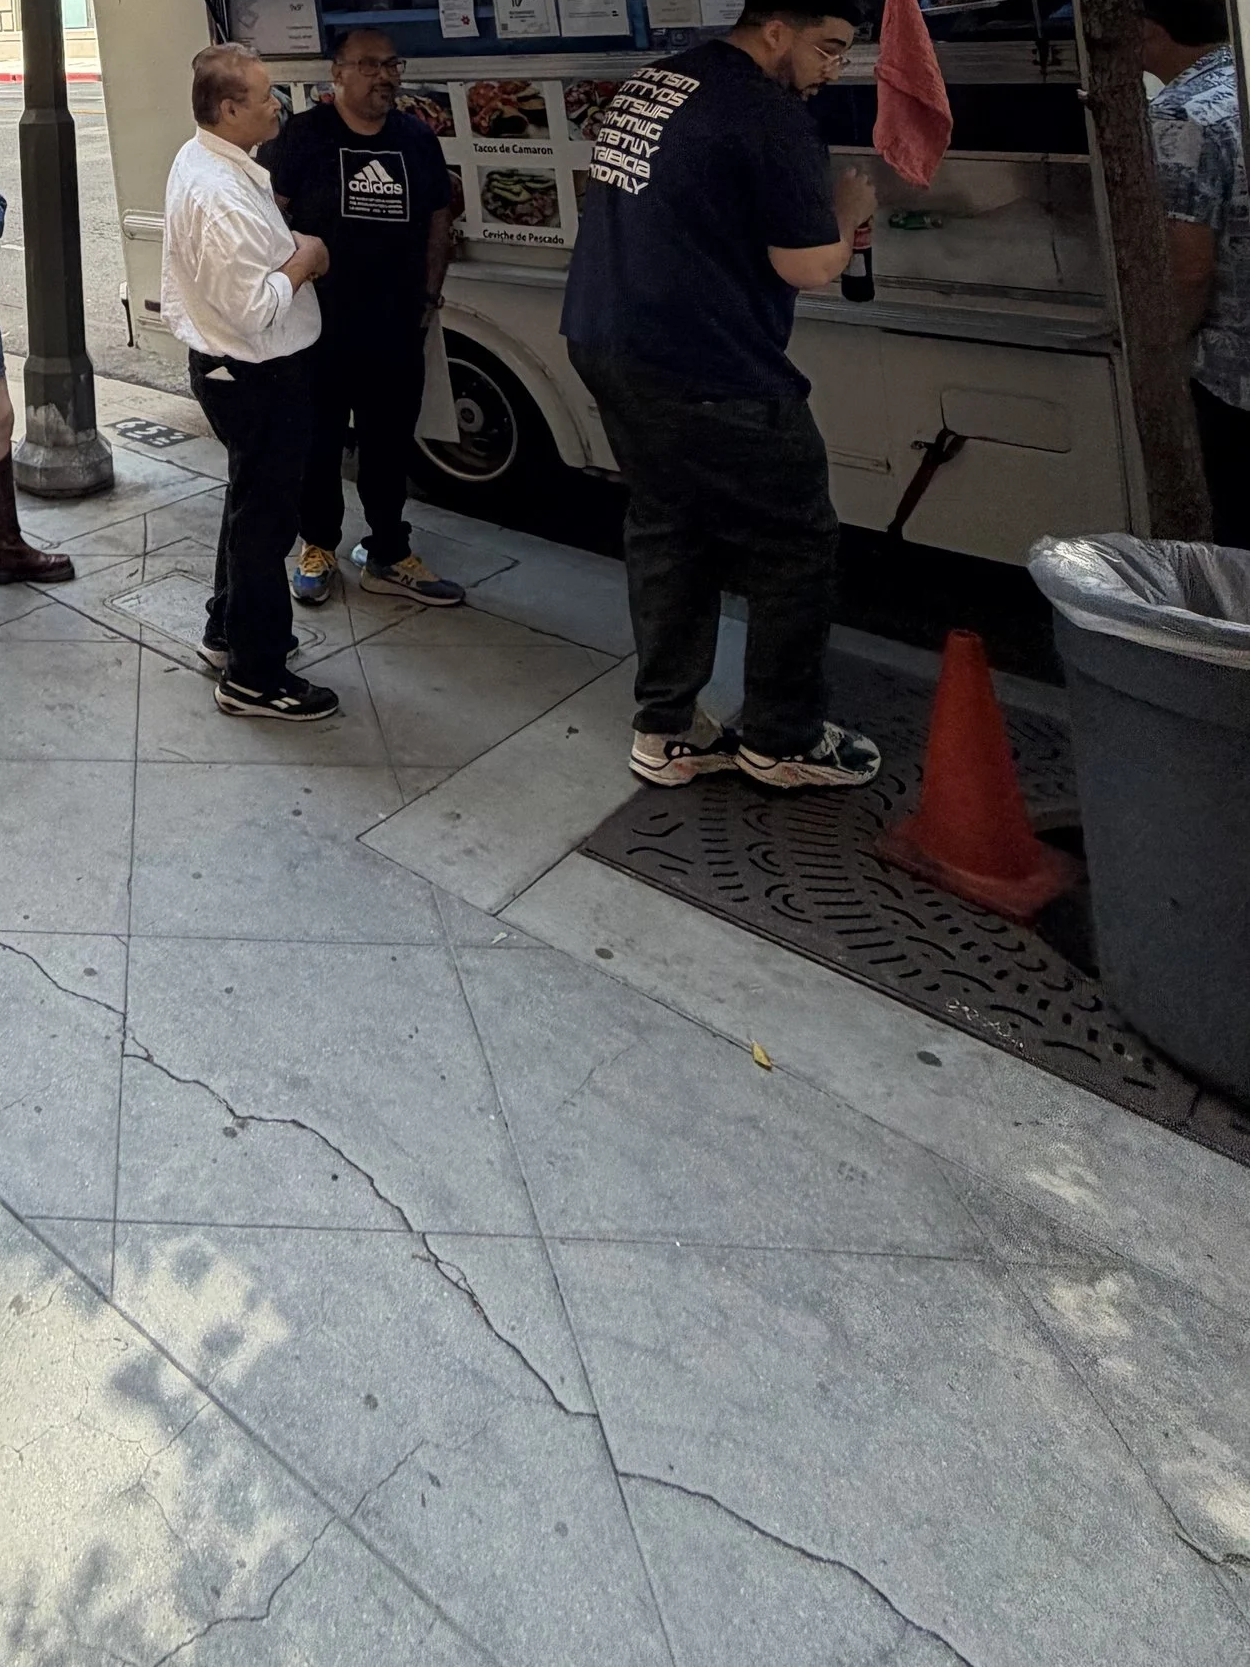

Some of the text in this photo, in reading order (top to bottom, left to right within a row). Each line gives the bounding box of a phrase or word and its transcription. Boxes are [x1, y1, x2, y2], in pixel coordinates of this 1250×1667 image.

[473, 143, 554, 155] Tacos de Camaron
[348, 179, 403, 195] adidas
[482, 229, 514, 240] Ceviche
[529, 233, 565, 245] Pescado
